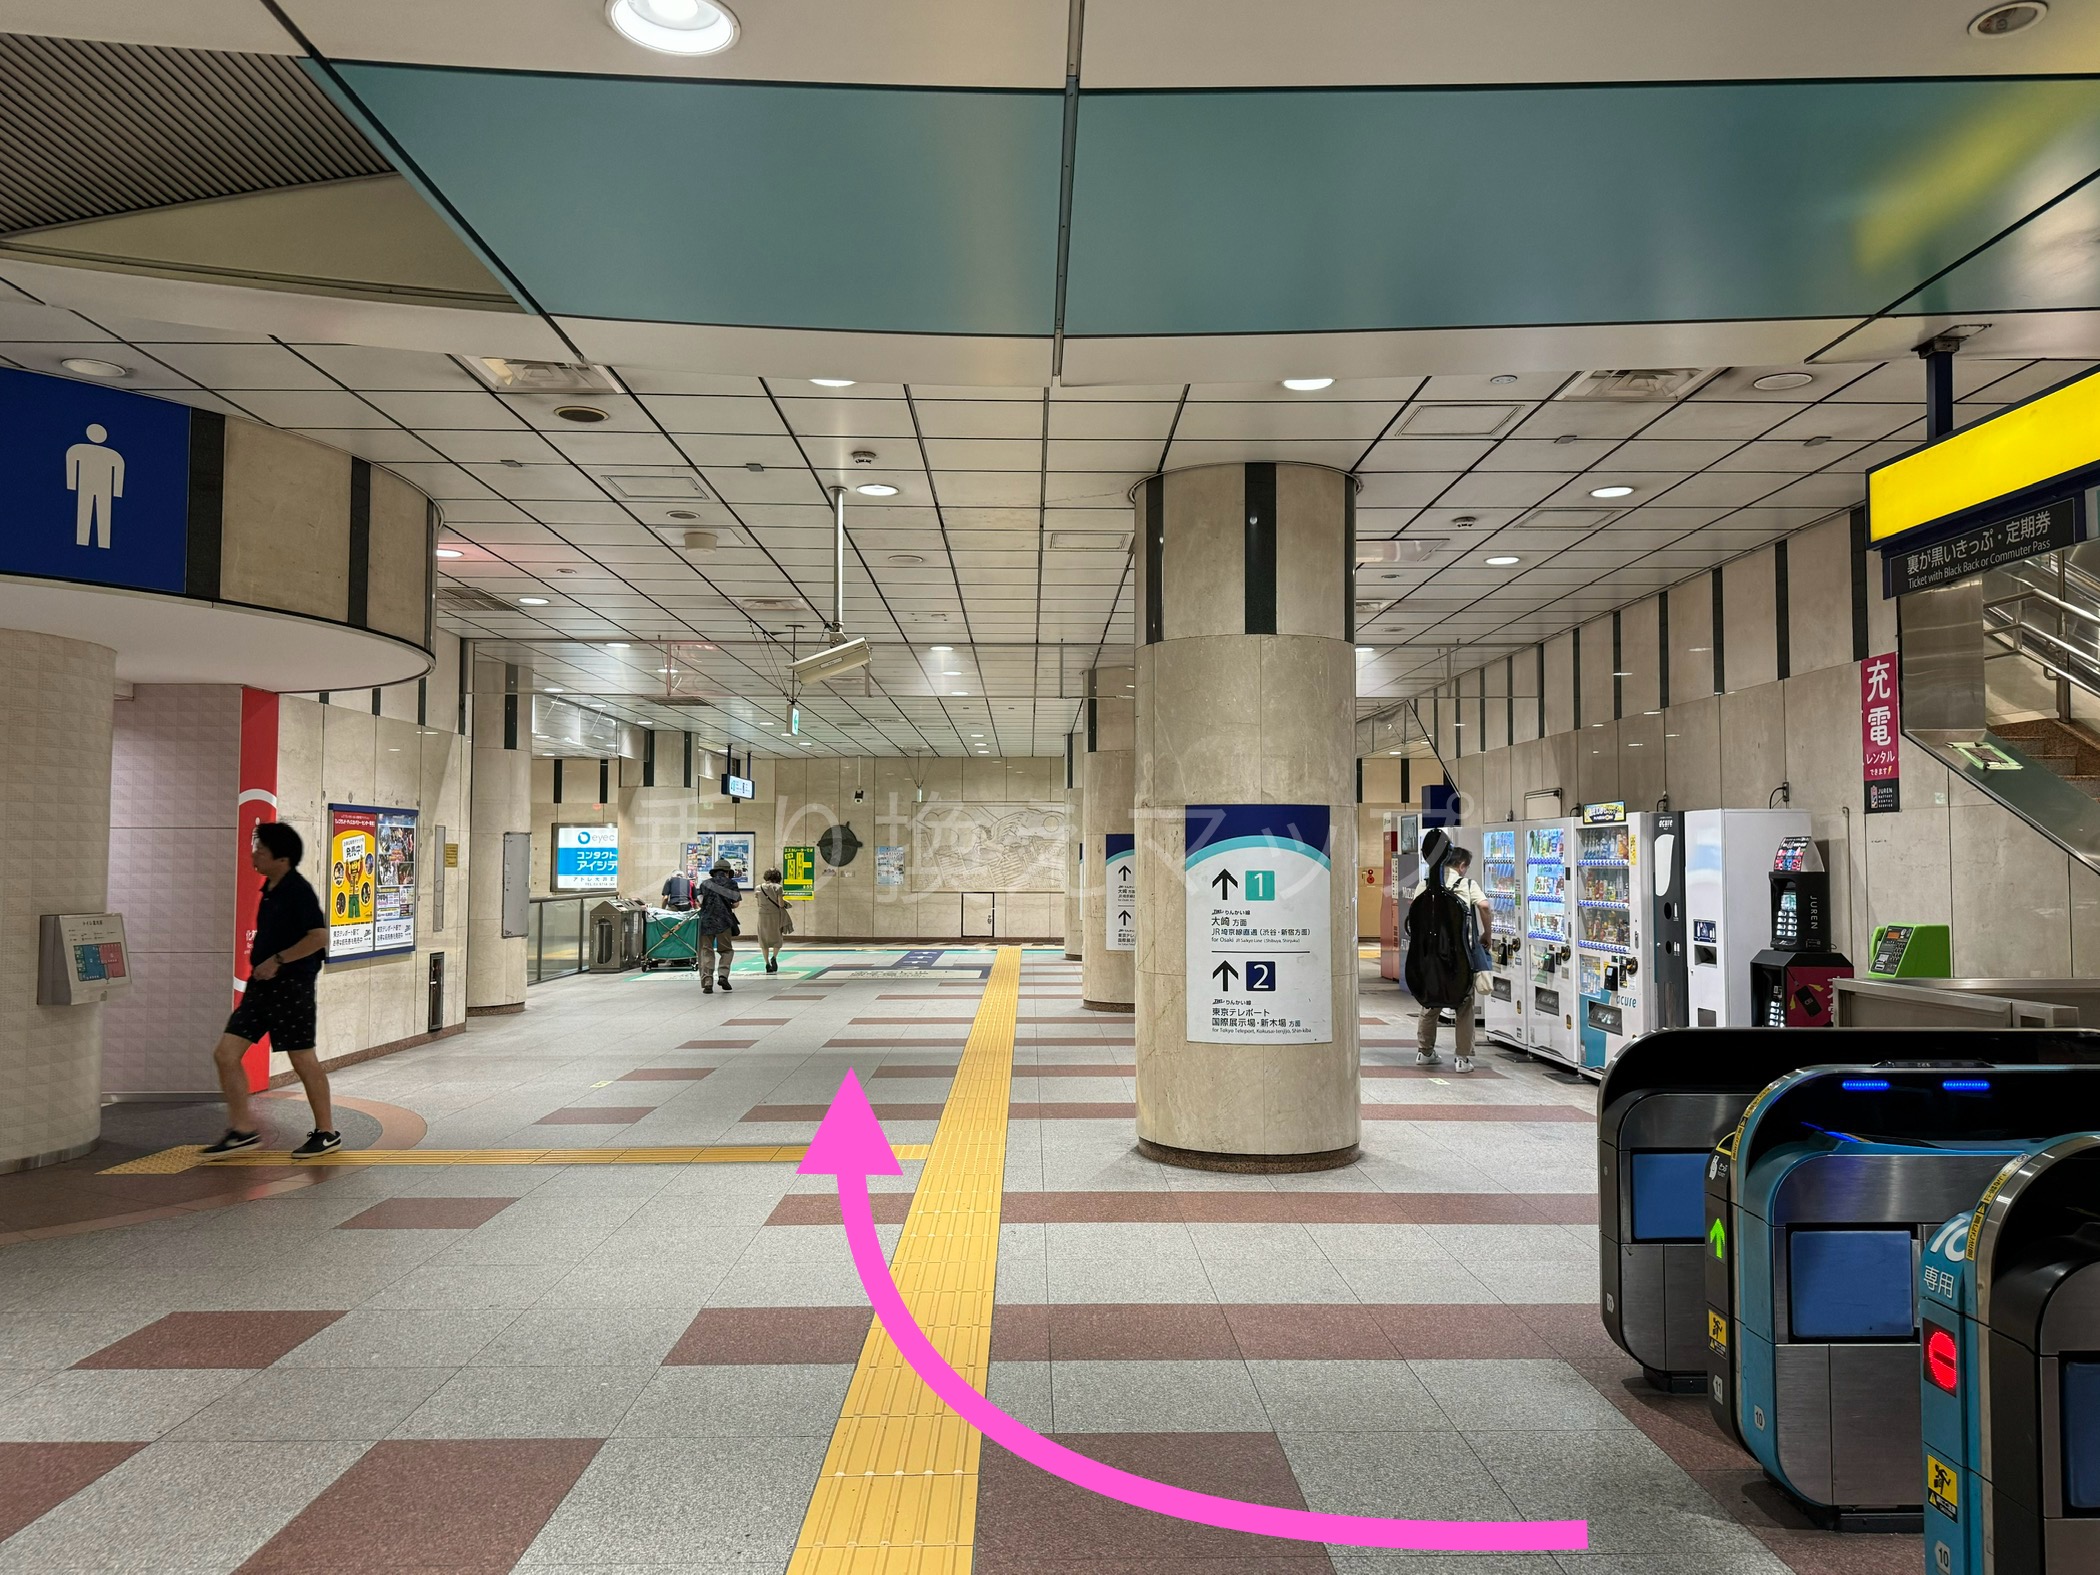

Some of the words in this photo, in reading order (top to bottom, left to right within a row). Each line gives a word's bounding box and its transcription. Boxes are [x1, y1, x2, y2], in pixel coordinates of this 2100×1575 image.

[1906, 510, 2051, 575] 裏が黒いきっぷ・定期券
[1908, 575, 1928, 589] Ticket
[1928, 570, 1944, 584] with
[1944, 565, 1963, 578] Black
[1962, 559, 1980, 572] Back
[1981, 557, 1989, 567] or
[1990, 546, 2031, 564] Commuter
[2032, 539, 2051, 552] Pass
[1867, 659, 1891, 746] 充電
[1866, 750, 1896, 765] レンタル
[1869, 766, 1888, 776] できます
[1878, 787, 1893, 795] JUREN
[577, 851, 618, 860] コンタクト
[1254, 872, 1263, 897] 1
[1810, 895, 1819, 930] JUREN
[1211, 916, 1230, 927] 大崎
[1232, 918, 1247, 927] 方面
[1253, 964, 1269, 989] 2
[1616, 995, 1637, 1009] acure
[1212, 1007, 1270, 1017] 東京テレポート
[1212, 1017, 1287, 1028] 国際展示場・新木場
[1288, 1019, 1301, 1027] 方面
[1930, 1218, 1969, 1262] IC
[1923, 1265, 1954, 1298] 専用
[1715, 1380, 1722, 1395] 11
[1755, 1410, 1763, 1427] 10
[1938, 1547, 1949, 1568] 10
